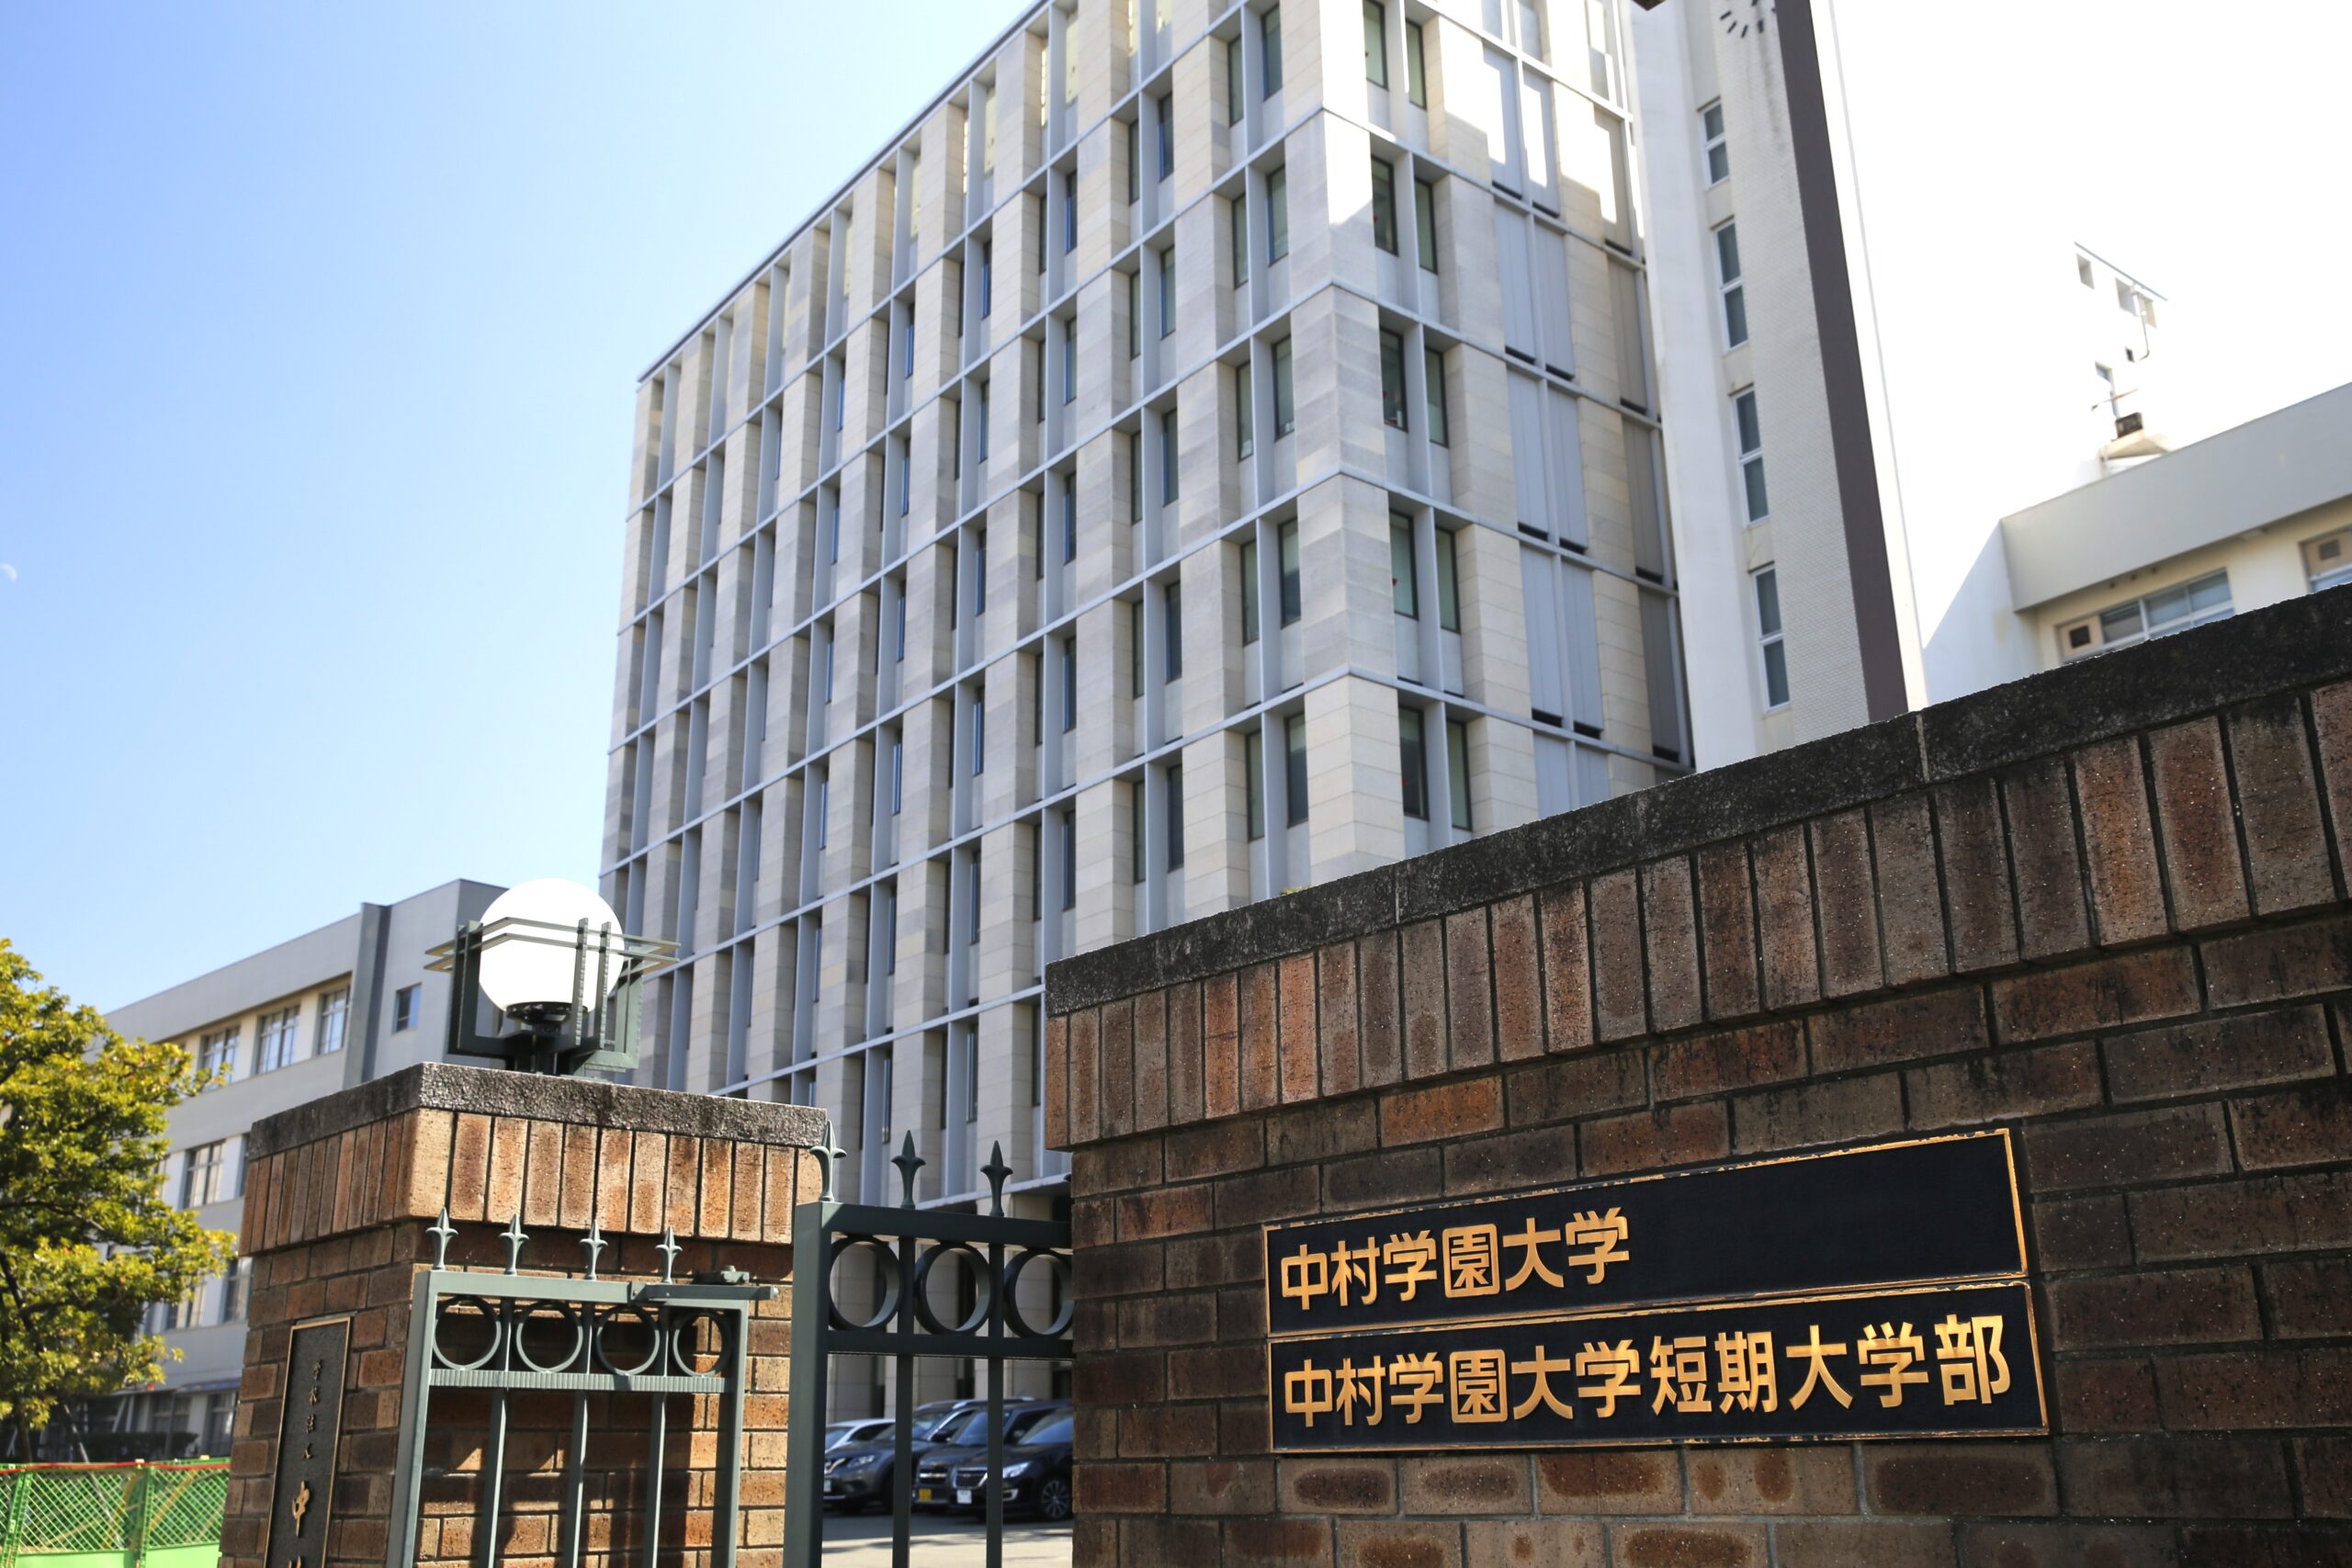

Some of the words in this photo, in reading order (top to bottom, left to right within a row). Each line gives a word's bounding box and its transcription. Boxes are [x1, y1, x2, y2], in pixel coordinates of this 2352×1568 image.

[1281, 1207, 1630, 1311] 中村学園大学
[1284, 1314, 2011, 1427] 中村学園大学短期大学部
